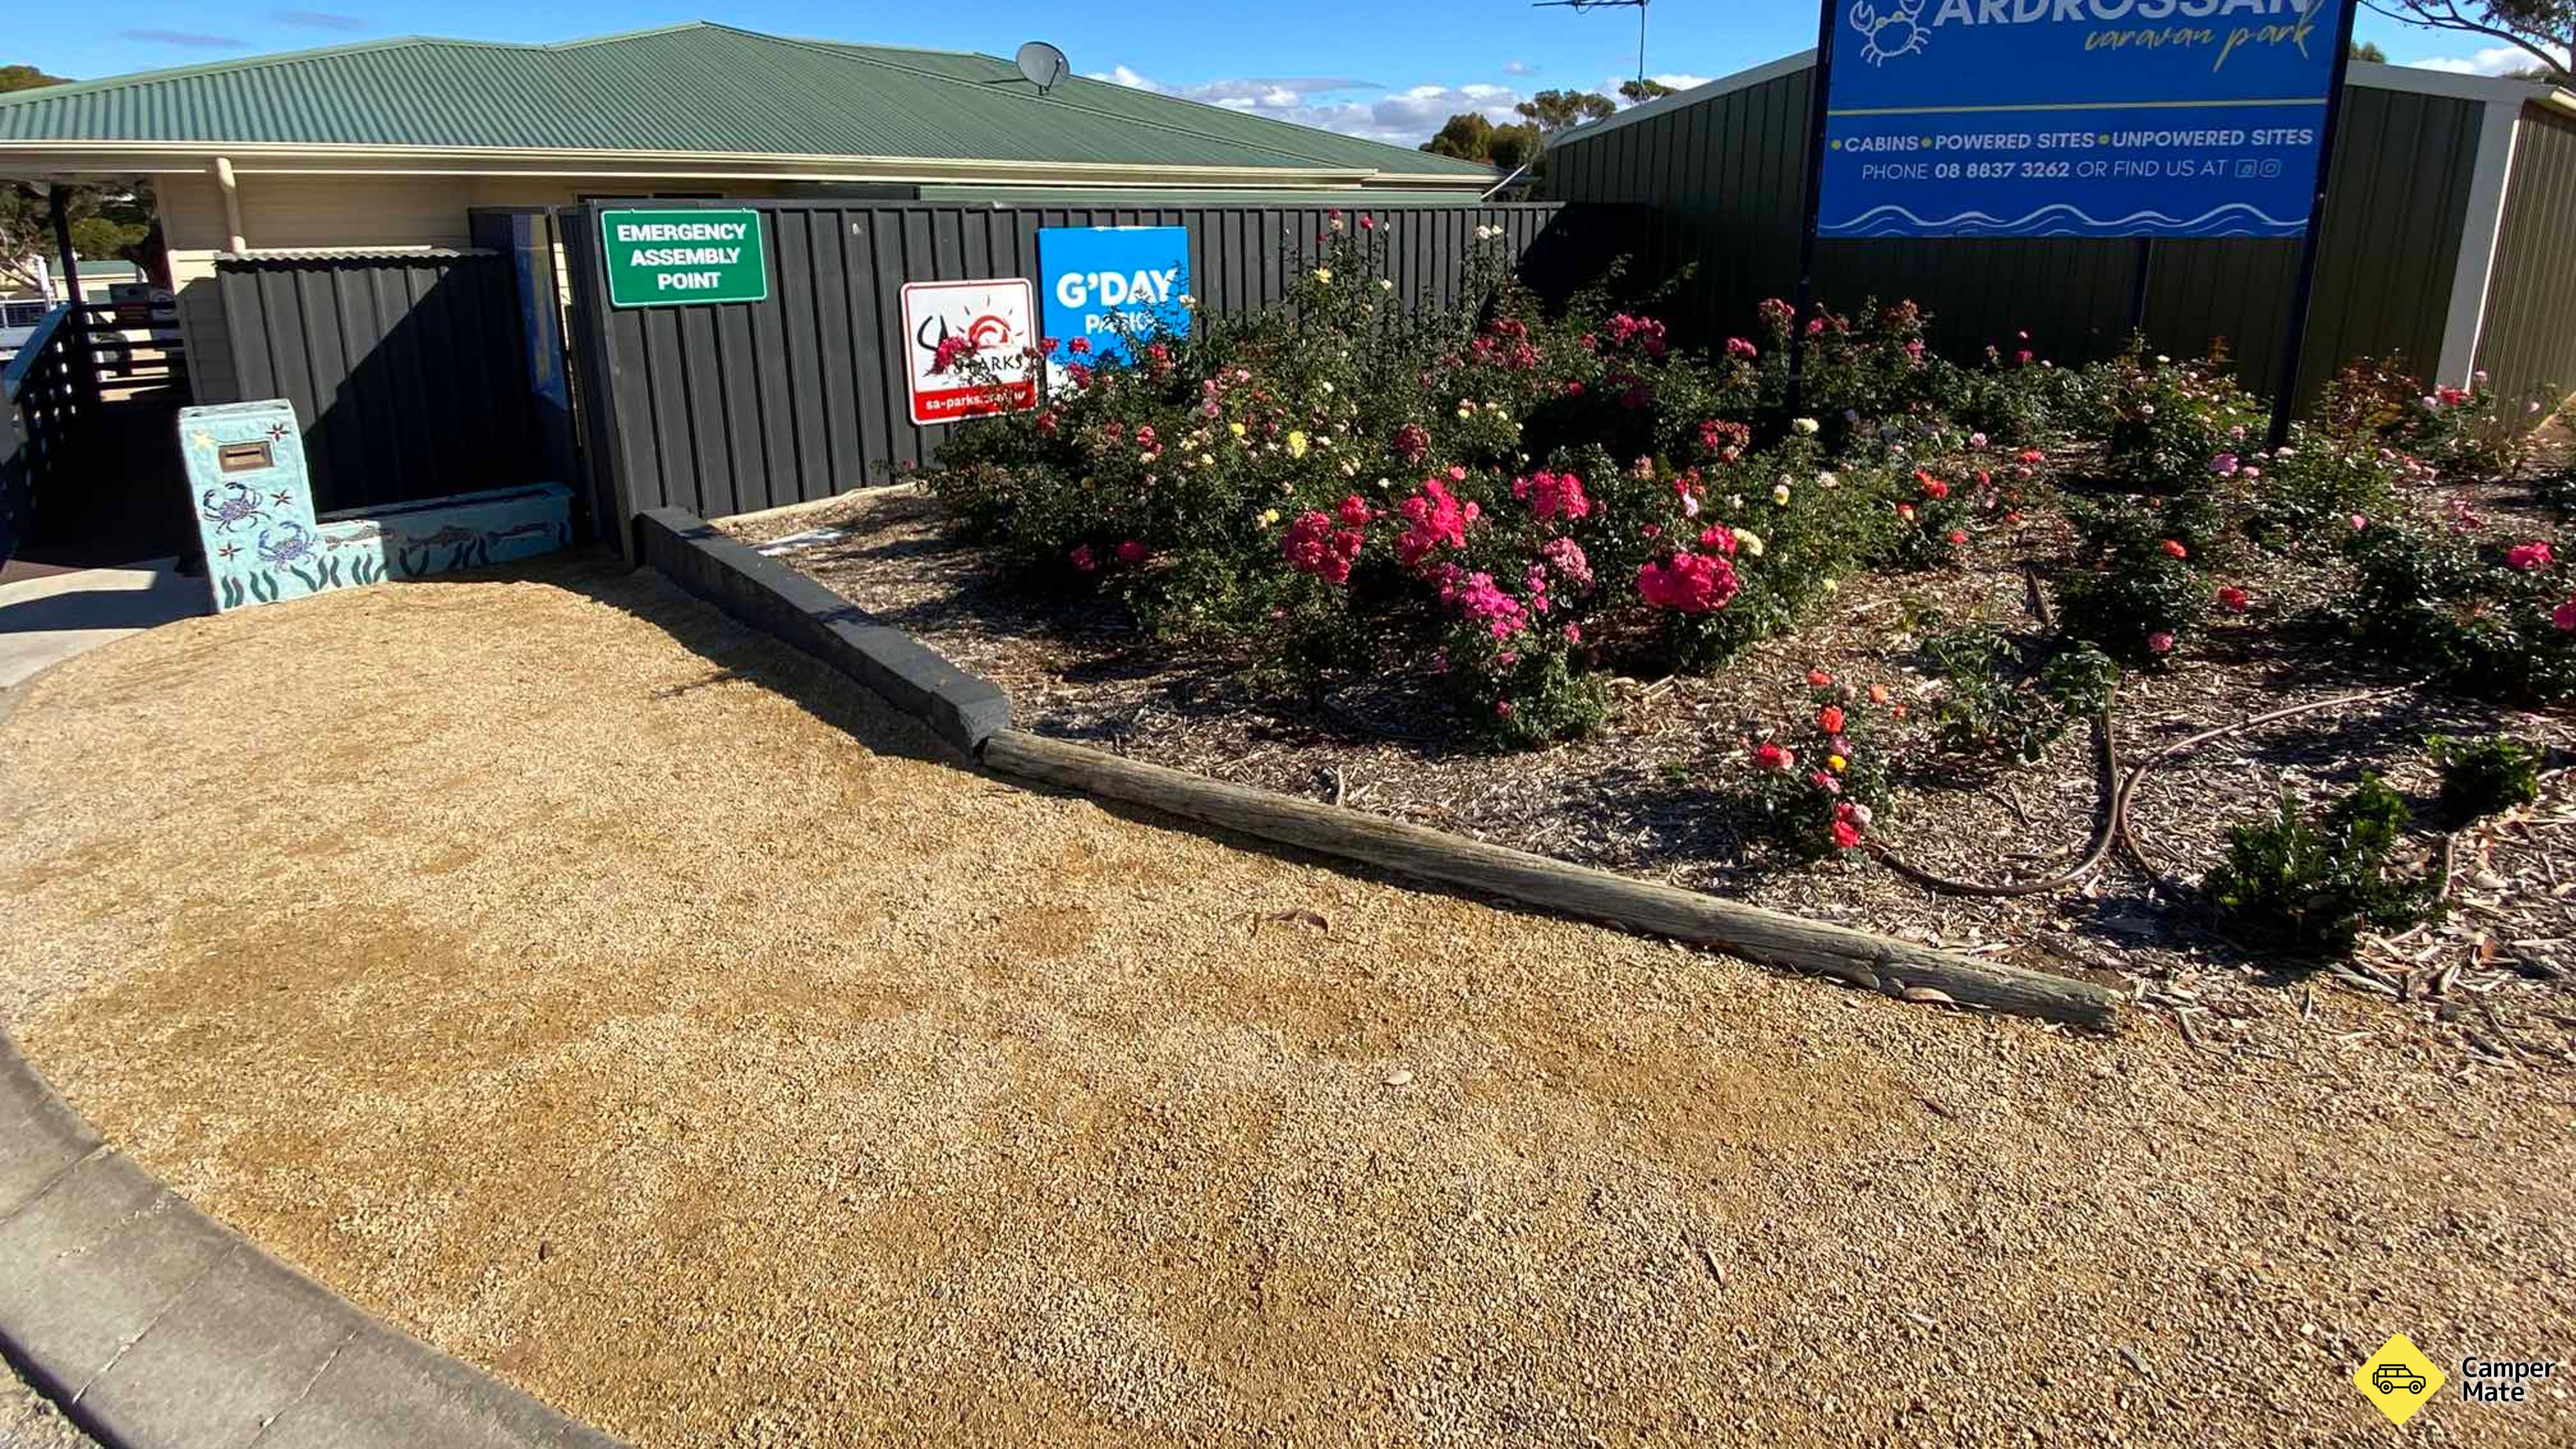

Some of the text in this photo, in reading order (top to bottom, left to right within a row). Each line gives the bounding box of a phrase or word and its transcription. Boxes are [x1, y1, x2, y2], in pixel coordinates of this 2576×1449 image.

[2085, 0, 2324, 72] caravan park
[1845, 128, 2313, 152] CABINS POWERED SITES UNPOWERED SITES
[1862, 159, 2229, 180] PHONE 08 8837 3262 OR FIND US AT
[617, 223, 747, 242] EMERGENCY
[630, 247, 741, 267] ASSEMBLY
[657, 272, 721, 290] POINT
[1056, 268, 1178, 308] G'DAY
[969, 354, 1023, 375] ARKS
